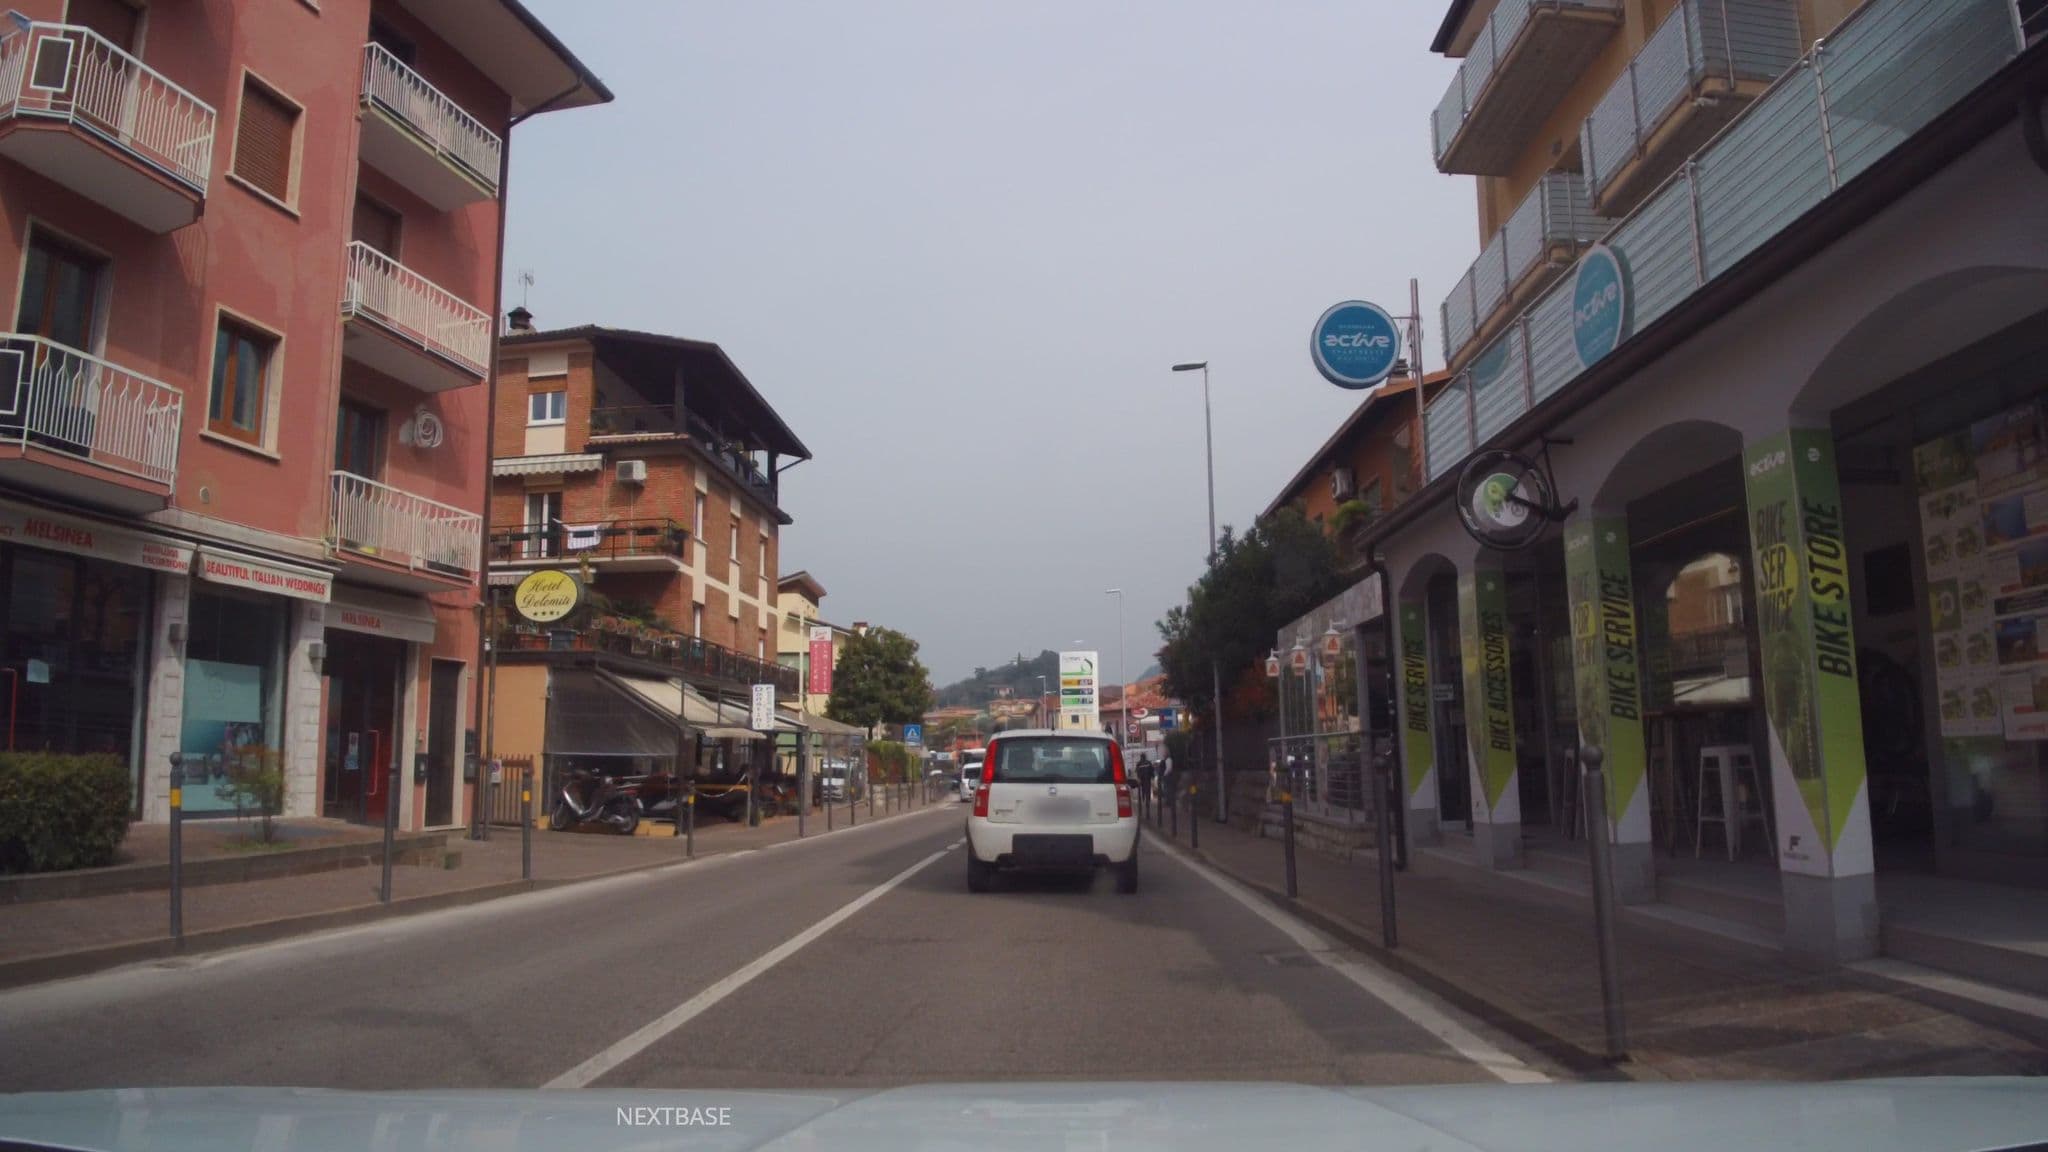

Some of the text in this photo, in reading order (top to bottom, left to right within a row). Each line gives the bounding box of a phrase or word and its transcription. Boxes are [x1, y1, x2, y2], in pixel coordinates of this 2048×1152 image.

[1325, 332, 1390, 347] active
[24, 518, 93, 549] MELSINEA
[1757, 502, 1787, 547] BIKE
[206, 560, 326, 596] BEAUTIFUL ITALIAN WEDDINGS
[528, 578, 563, 593] Hotel
[1759, 544, 1787, 592] SER
[1802, 496, 1853, 679] BIKE STORE
[1600, 569, 1639, 721] BIKE SERVICE
[1481, 608, 1512, 752] BIKE ACCESSORIES
[1407, 698, 1429, 732] BIKE
